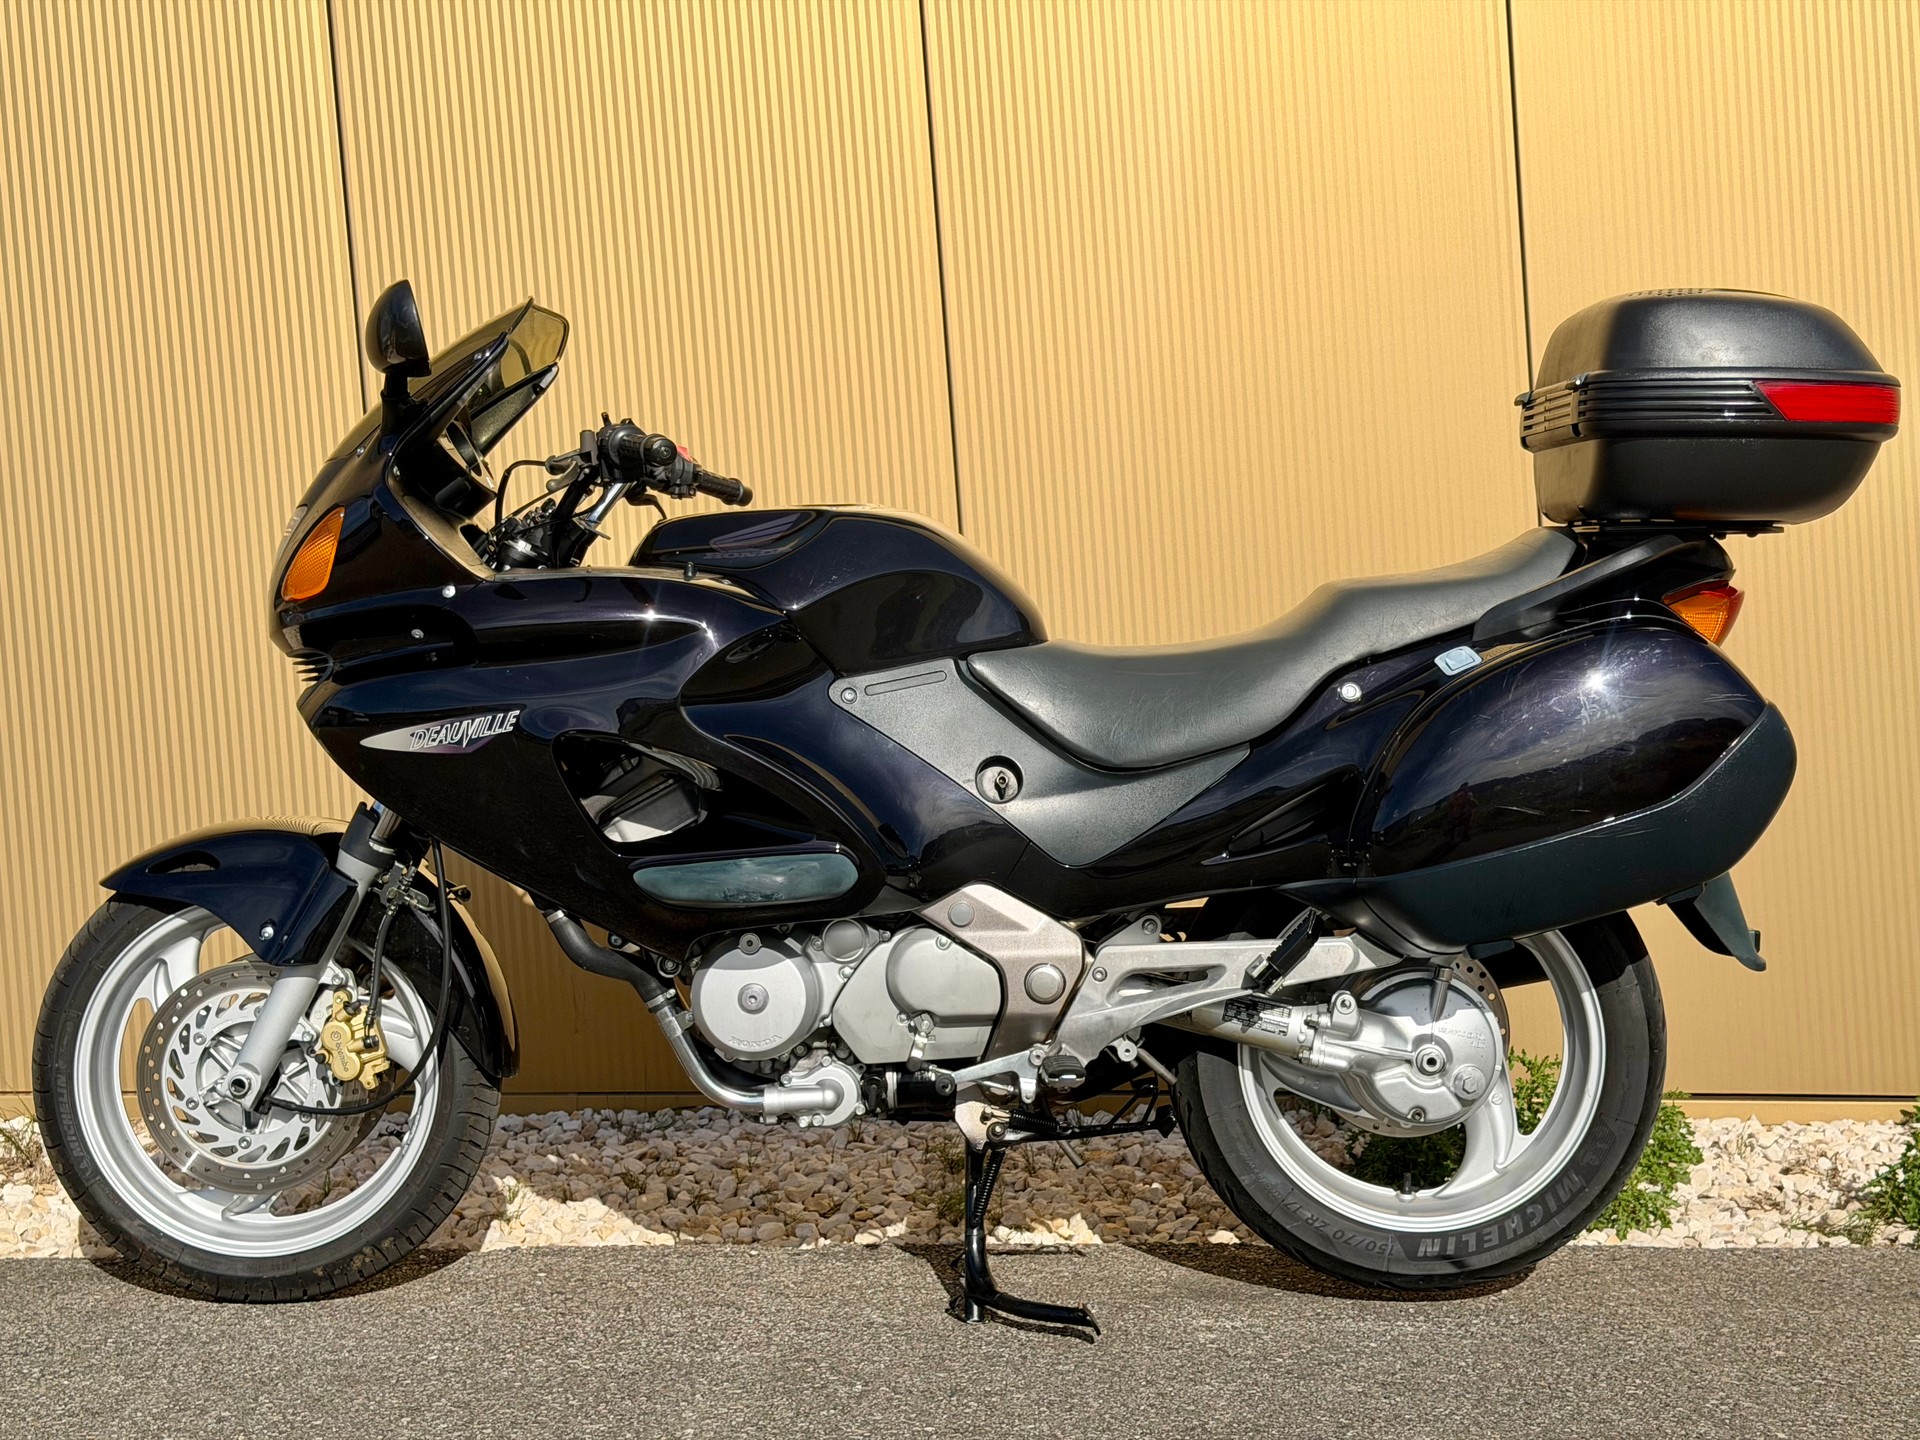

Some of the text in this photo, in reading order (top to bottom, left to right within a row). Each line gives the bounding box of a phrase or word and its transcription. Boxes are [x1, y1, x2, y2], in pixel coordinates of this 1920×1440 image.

[410, 709, 521, 751] DEAUVILLE
[335, 1042, 350, 1073] brembo
[56, 1073, 84, 1157] MICHELIN
[1282, 1201, 1303, 1215] 17
[1416, 1169, 1587, 1259] MICHELIN
[1305, 1215, 1330, 1233] ZR
[1332, 1228, 1396, 1258] 150/70
